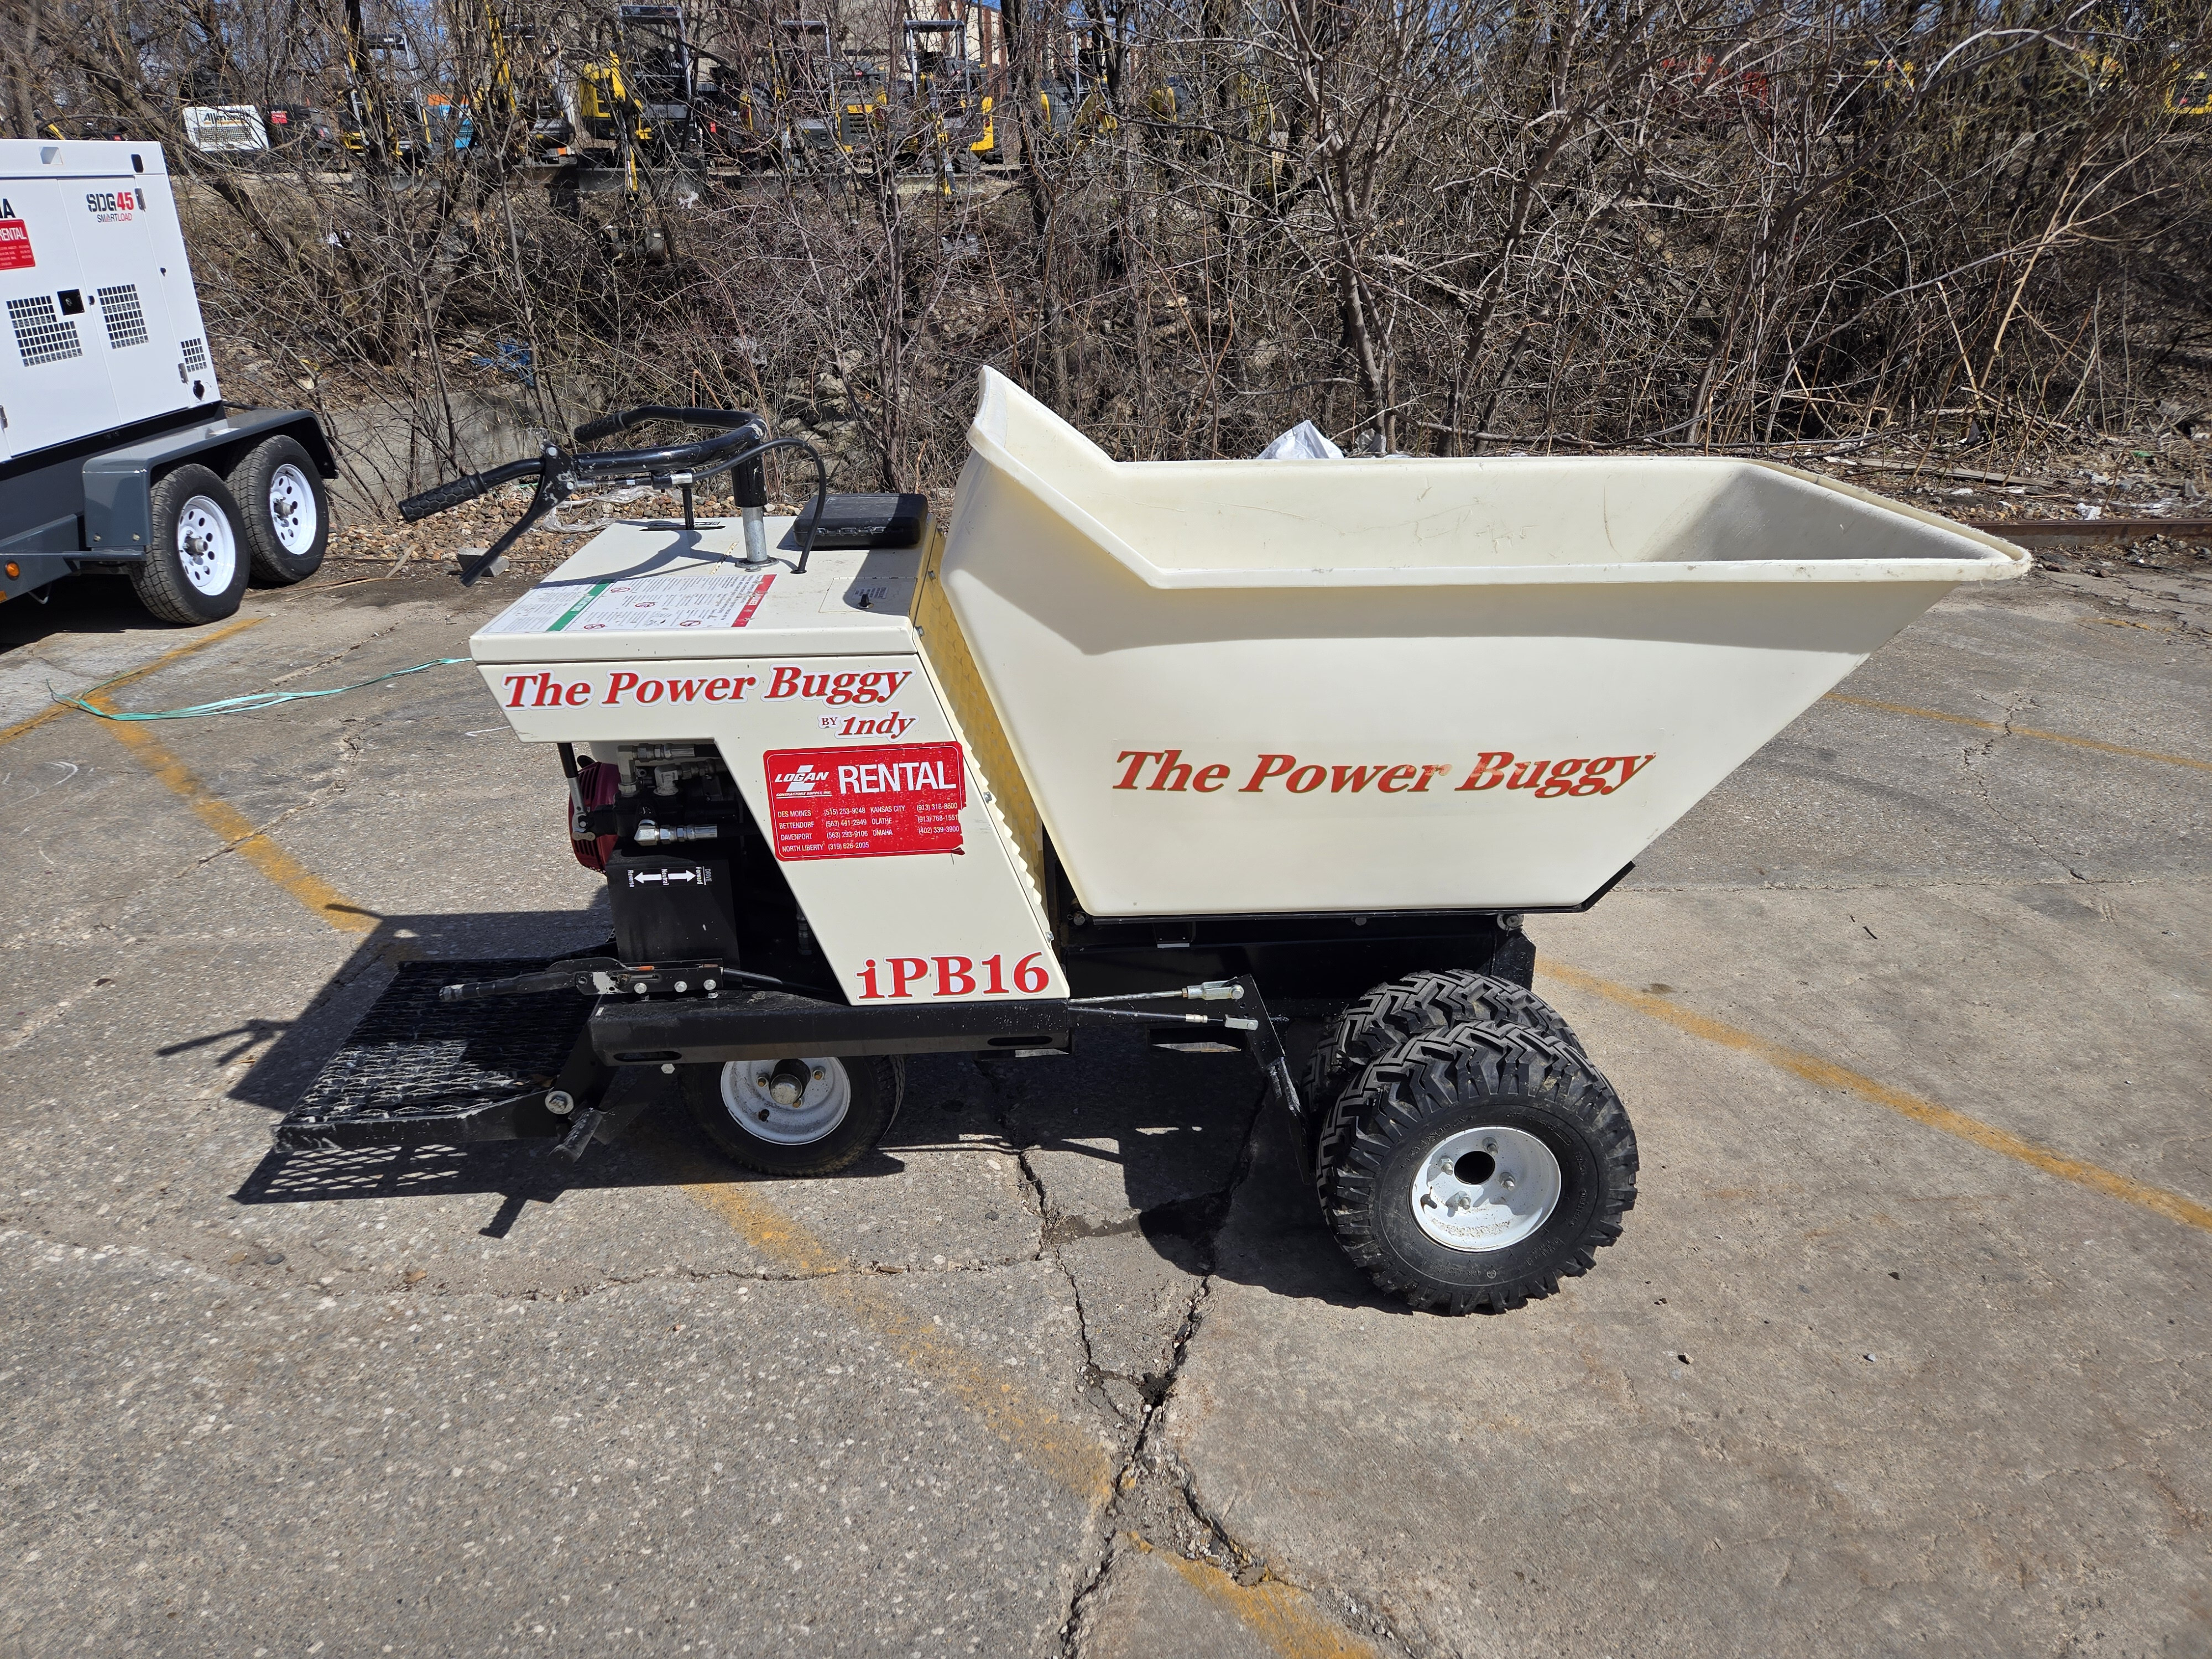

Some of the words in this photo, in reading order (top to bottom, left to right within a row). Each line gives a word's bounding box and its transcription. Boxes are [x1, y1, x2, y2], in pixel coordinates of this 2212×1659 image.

[0, 198, 16, 219] A
[86, 192, 134, 212] SDG45
[504, 672, 592, 708] The
[602, 672, 756, 704] Power
[764, 666, 913, 705] Buggy
[821, 717, 838, 726] BY
[774, 771, 830, 782] LOGAN
[837, 760, 957, 794] RENTAL
[1112, 749, 1231, 793] The
[1238, 754, 1453, 794] Power
[1455, 752, 1657, 799] Buggy
[824, 808, 838, 816] (515)
[825, 820, 839, 828] (563)
[780, 833, 813, 841] DAVENPORT
[802, 843, 824, 852] LIBERTY
[661, 869, 670, 885] Neutral
[695, 867, 703, 885] Forward
[857, 951, 1050, 999] iPB16
